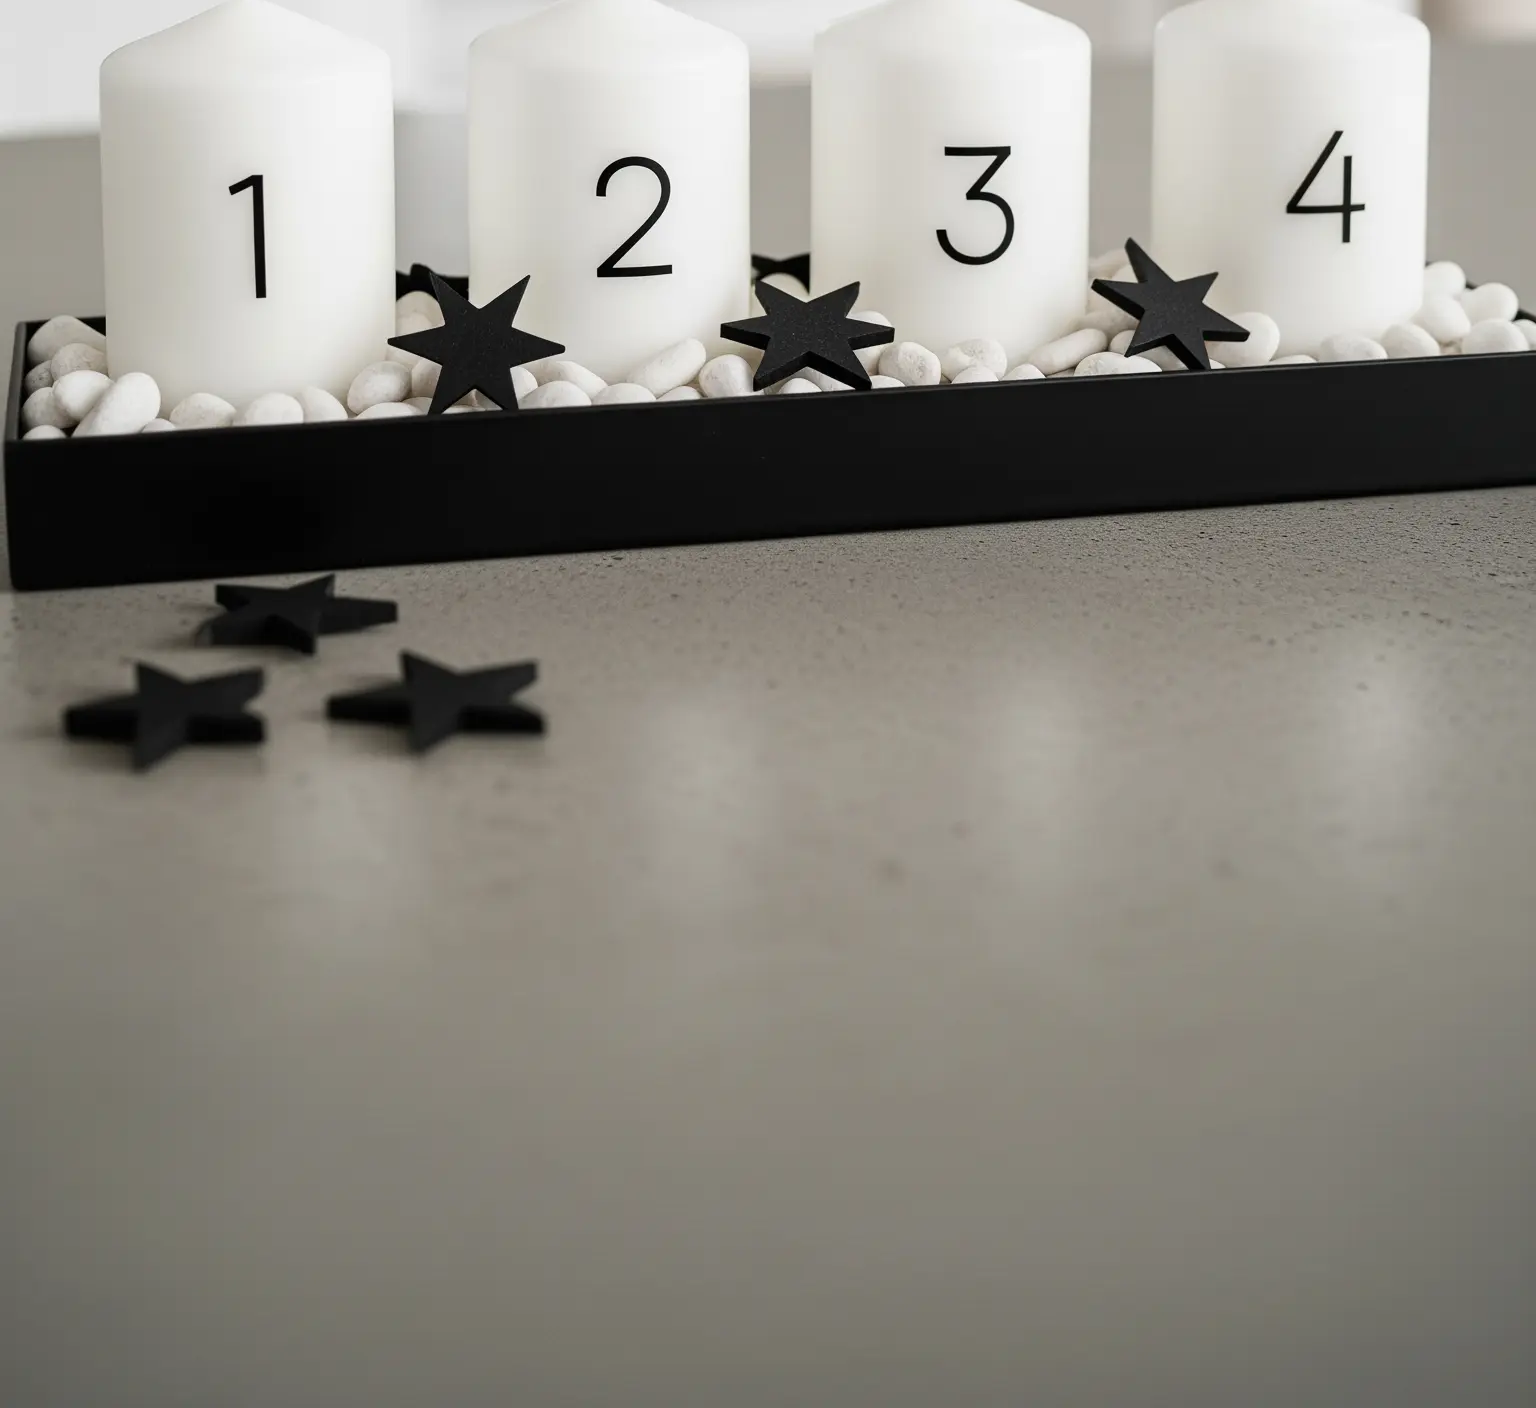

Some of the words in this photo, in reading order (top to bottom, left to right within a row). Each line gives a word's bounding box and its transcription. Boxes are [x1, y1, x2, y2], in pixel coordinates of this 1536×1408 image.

[228, 174, 267, 299] 1
[595, 156, 673, 278] 2
[935, 145, 1015, 266] 3
[1285, 130, 1365, 243] 4
